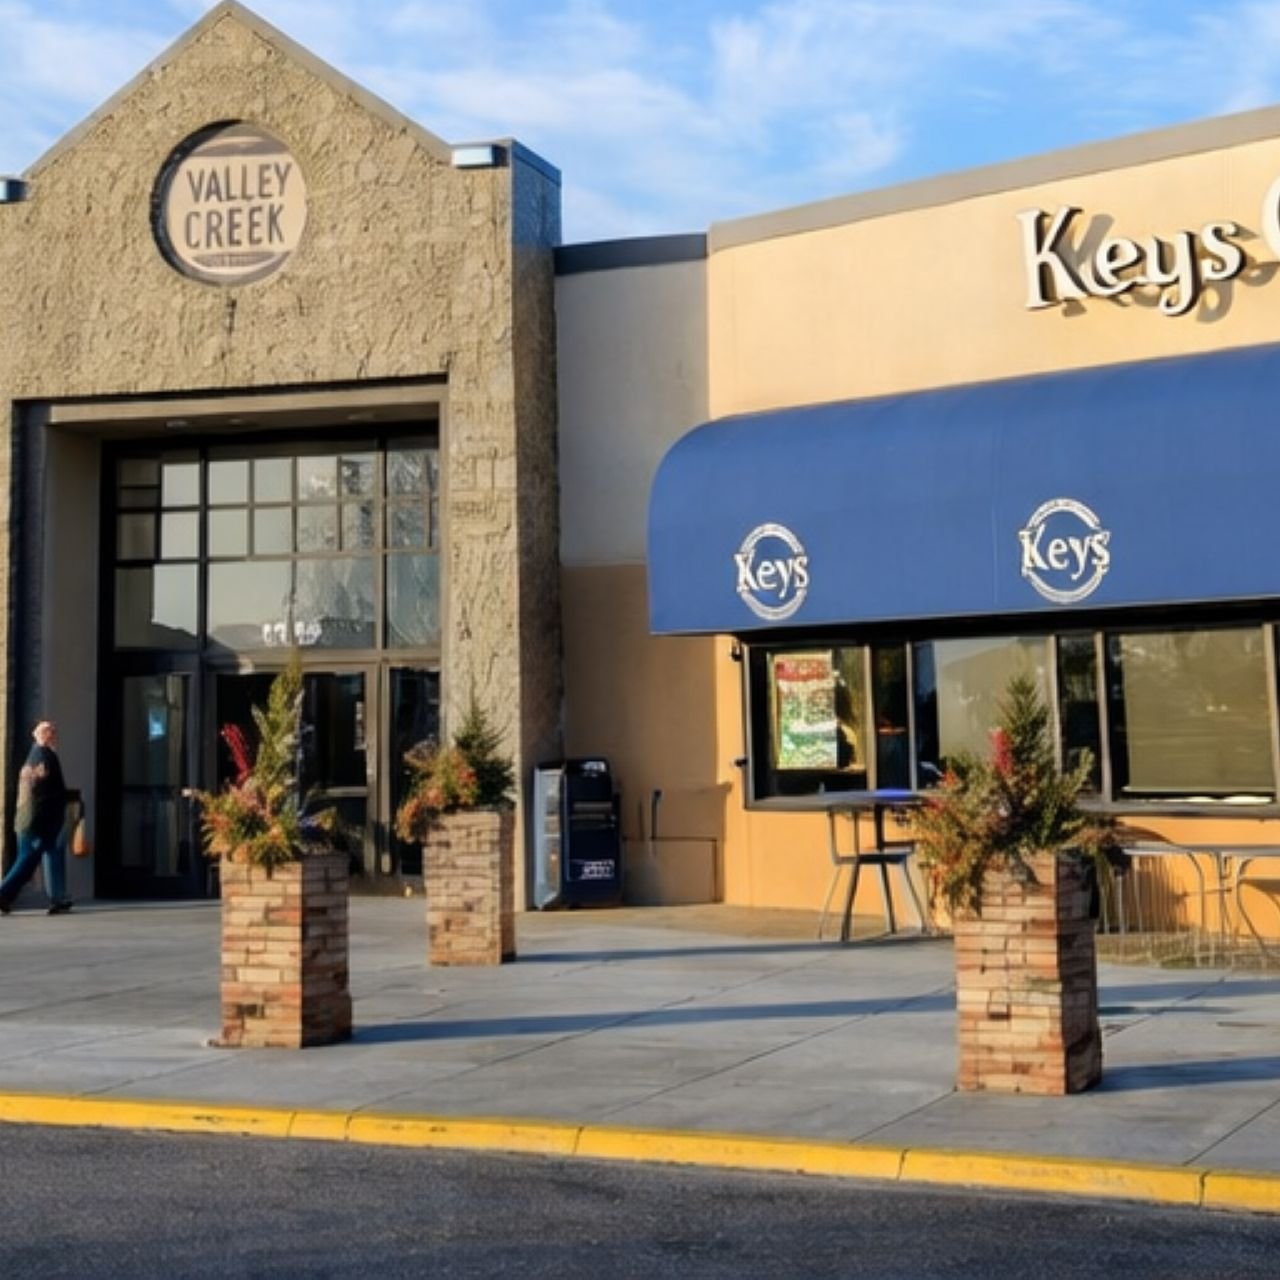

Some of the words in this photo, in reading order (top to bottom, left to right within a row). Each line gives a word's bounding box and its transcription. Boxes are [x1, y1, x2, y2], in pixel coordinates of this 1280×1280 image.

[186, 162, 292, 203] VALLEY
[184, 204, 285, 249] CREEK
[1017, 206, 1245, 316] Keys
[734, 548, 809, 599] Keys
[1019, 523, 1111, 581] Keys
